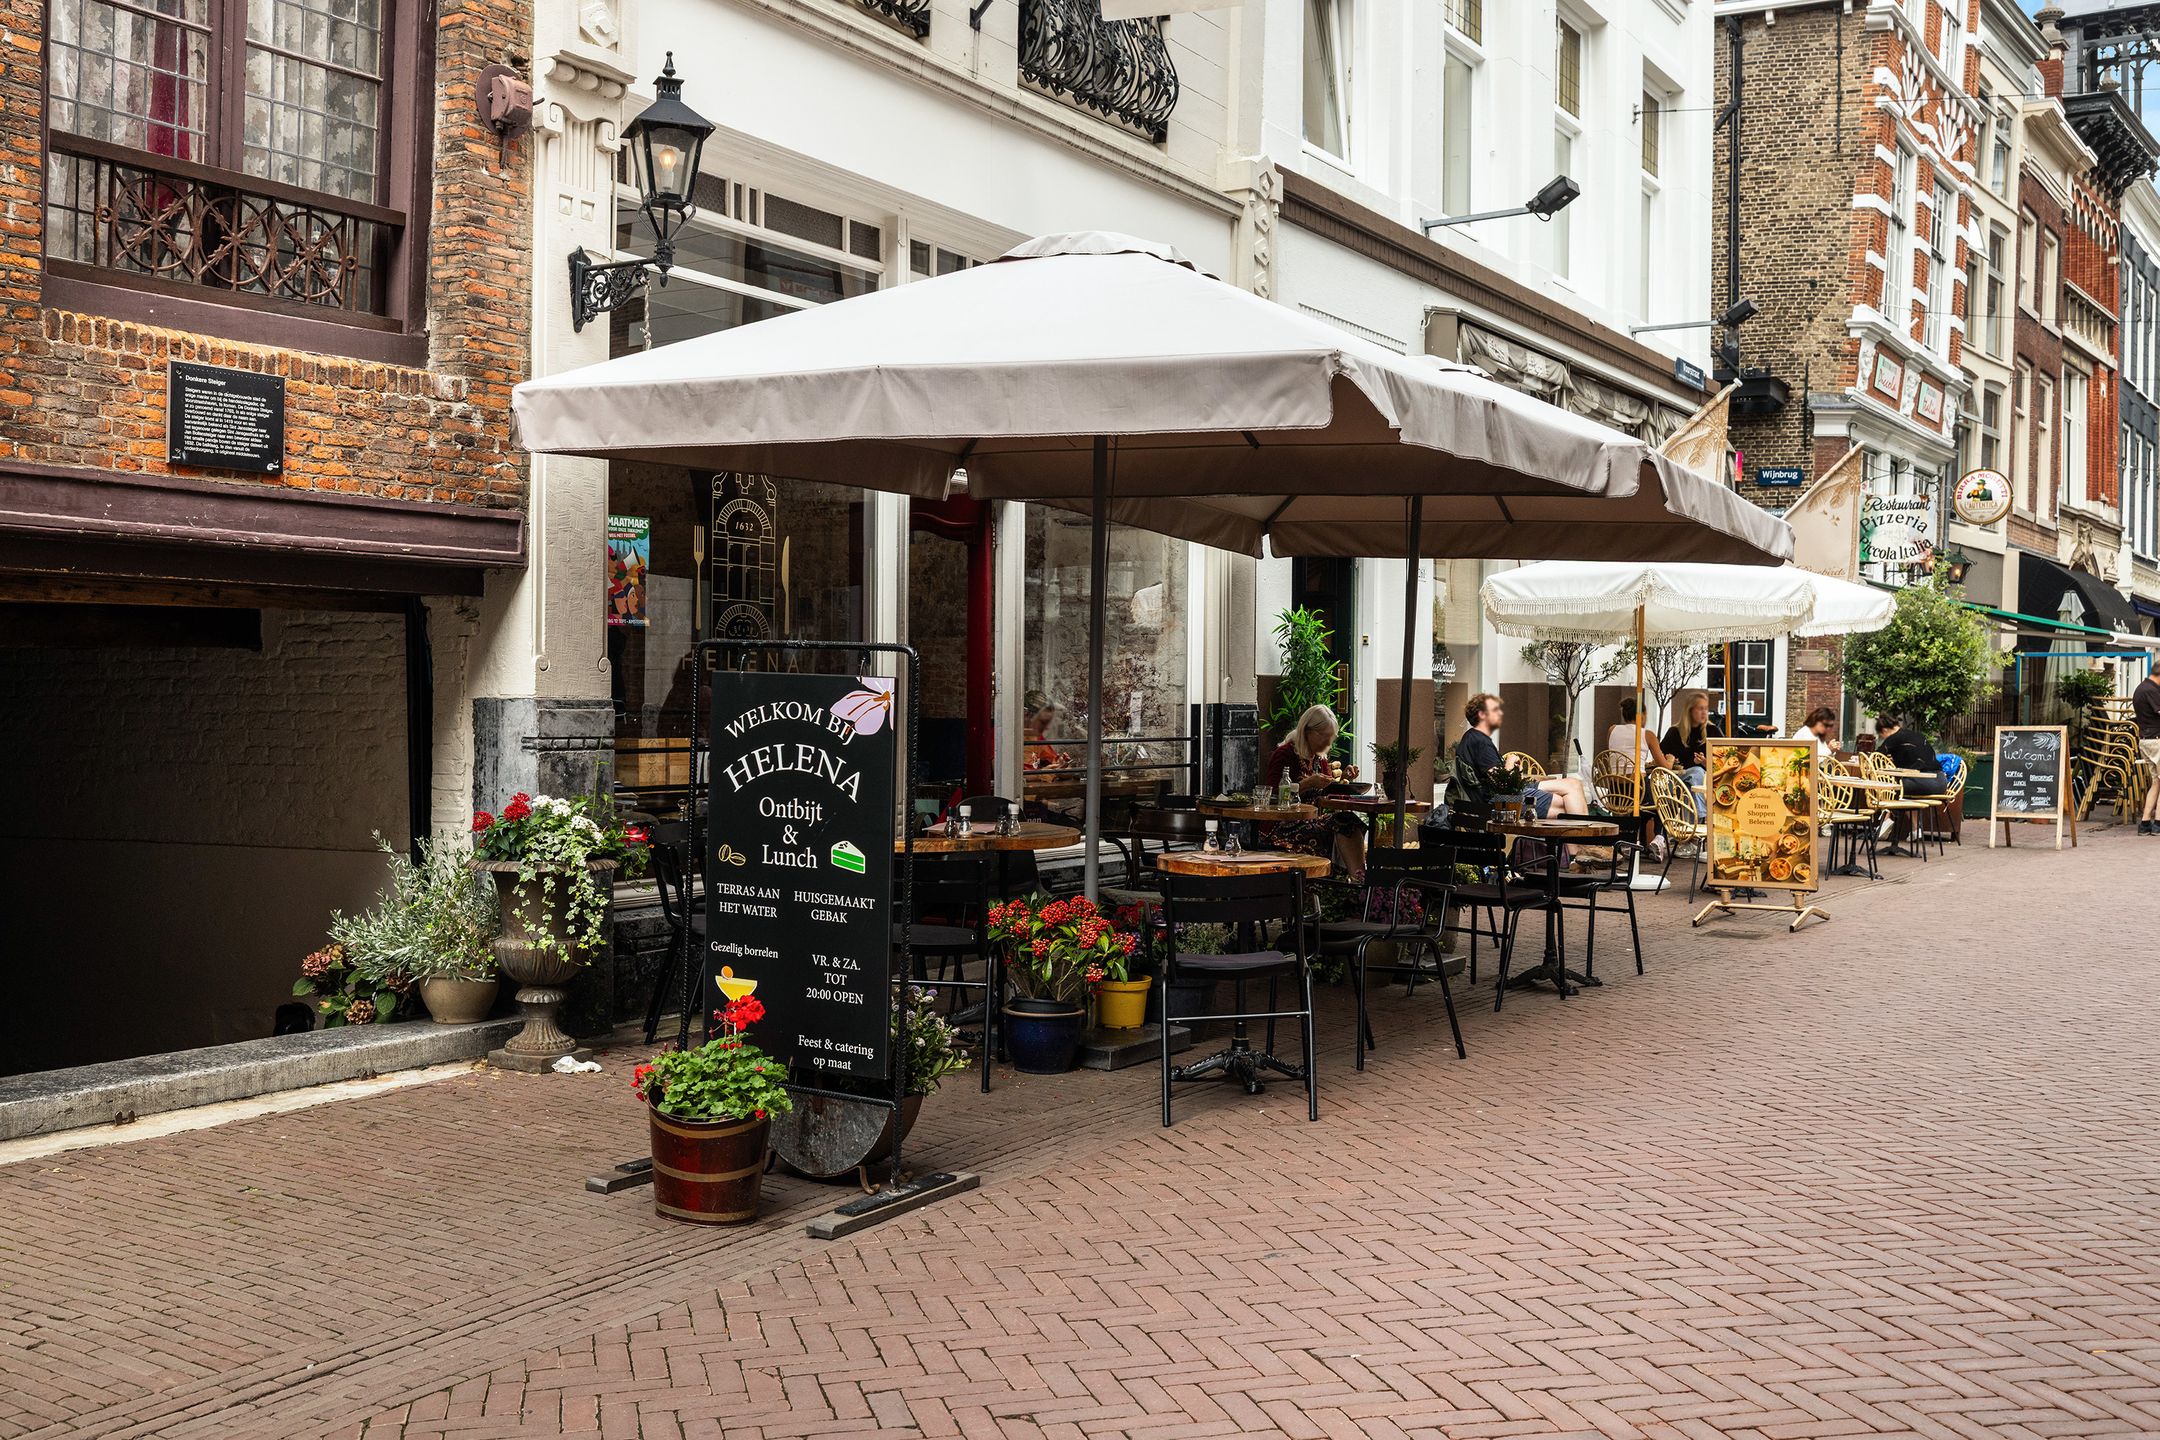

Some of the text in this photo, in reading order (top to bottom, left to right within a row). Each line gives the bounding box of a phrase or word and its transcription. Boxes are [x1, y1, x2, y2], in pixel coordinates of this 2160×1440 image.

[1762, 470, 1798, 479] Wijnbrug
[1957, 476, 1976, 500] BIRRA
[1862, 497, 1930, 512] Restaurant
[735, 521, 754, 531] 1632
[1860, 513, 1928, 533] Pizzeria
[1860, 536, 1933, 560] Piccola Italia
[682, 650, 800, 673] HELENA
[725, 702, 858, 745] WELKOM BIJ
[723, 744, 863, 803] HELENA
[759, 797, 823, 827] Ontbijt
[783, 824, 799, 845] &
[762, 844, 818, 869] Lunch
[717, 883, 780, 900] TERRAS AAN
[794, 891, 875, 910] HUISGEMAAKT
[719, 902, 778, 918] HET WATER
[811, 909, 847, 924] GEBAK
[711, 941, 778, 959] Gezellig borrelen
[812, 955, 861, 971] VR. & ZA.
[824, 972, 847, 986] TOT
[806, 988, 864, 1005] 20:00 OPEN
[798, 1035, 874, 1060] Feest & catering
[813, 1057, 851, 1070] op maat
